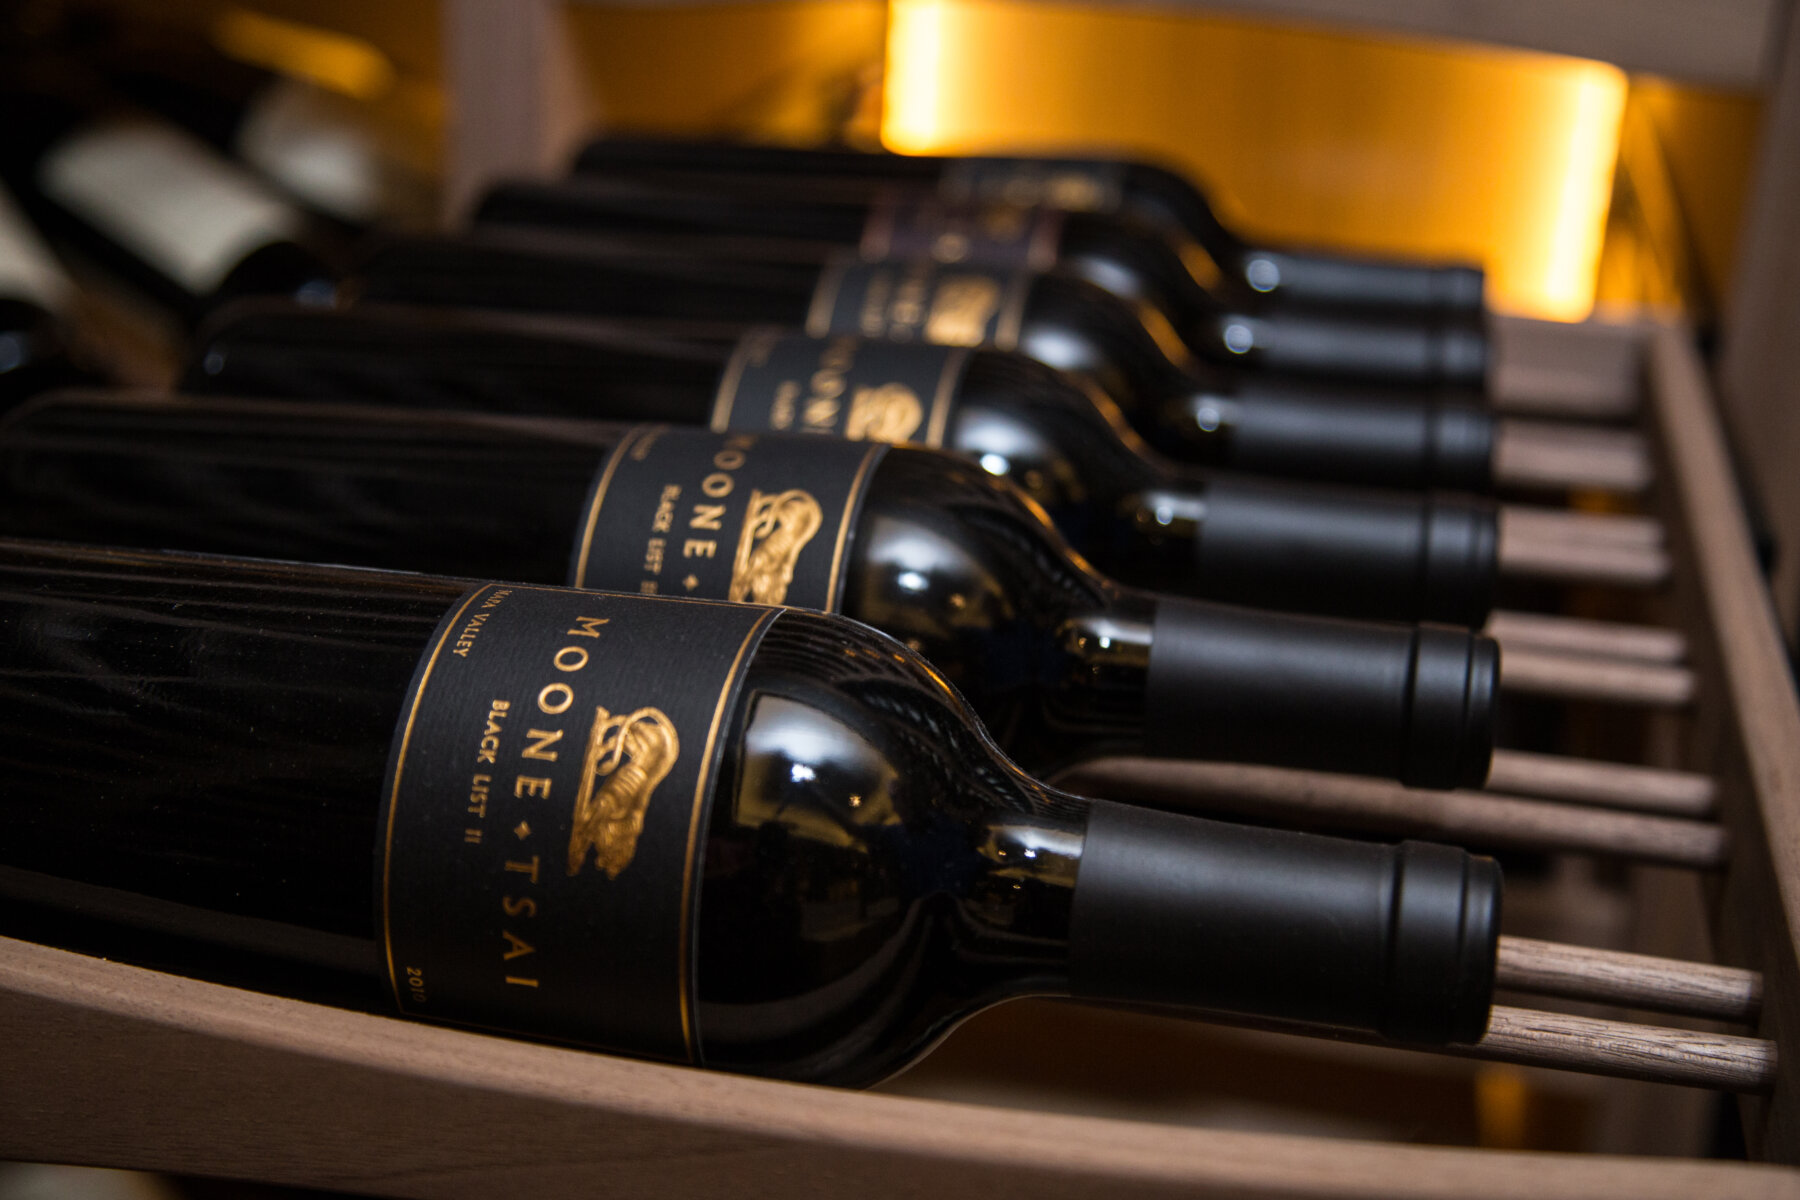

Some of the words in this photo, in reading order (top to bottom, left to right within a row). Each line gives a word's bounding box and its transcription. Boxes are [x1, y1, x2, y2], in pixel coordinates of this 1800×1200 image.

[481, 589, 513, 608] NAPA
[453, 613, 490, 658] VALLEY
[514, 615, 609, 799] MOONE
[477, 699, 511, 764] BLACK
[467, 774, 492, 818] LIST
[464, 828, 483, 844] II
[503, 855, 540, 988] TSAI
[406, 966, 427, 1003] 2010
